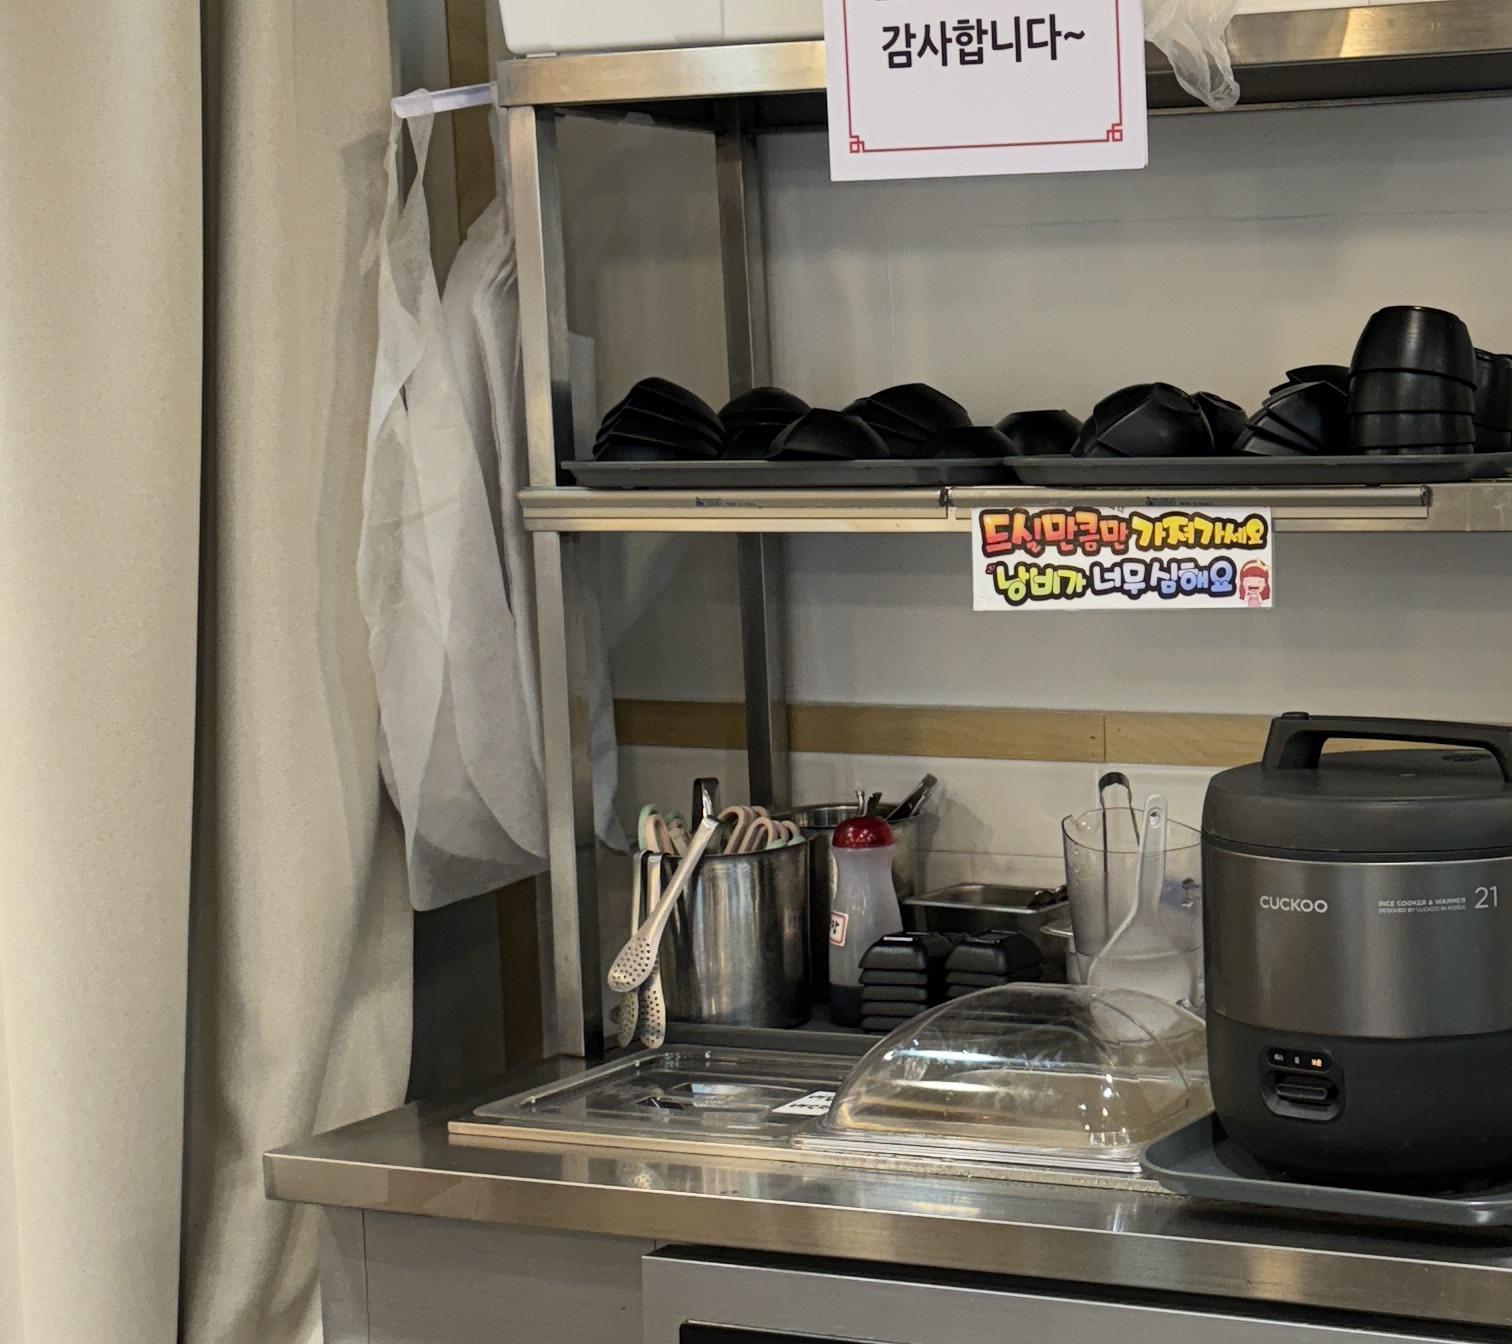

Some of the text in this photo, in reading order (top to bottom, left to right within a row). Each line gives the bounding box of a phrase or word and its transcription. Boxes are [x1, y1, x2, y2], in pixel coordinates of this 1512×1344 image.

[881, 13, 1086, 69] 감사합니다~
[992, 560, 1088, 606] 낭비가
[1259, 895, 1328, 913] CUCKOO
[1474, 886, 1499, 909] 21
